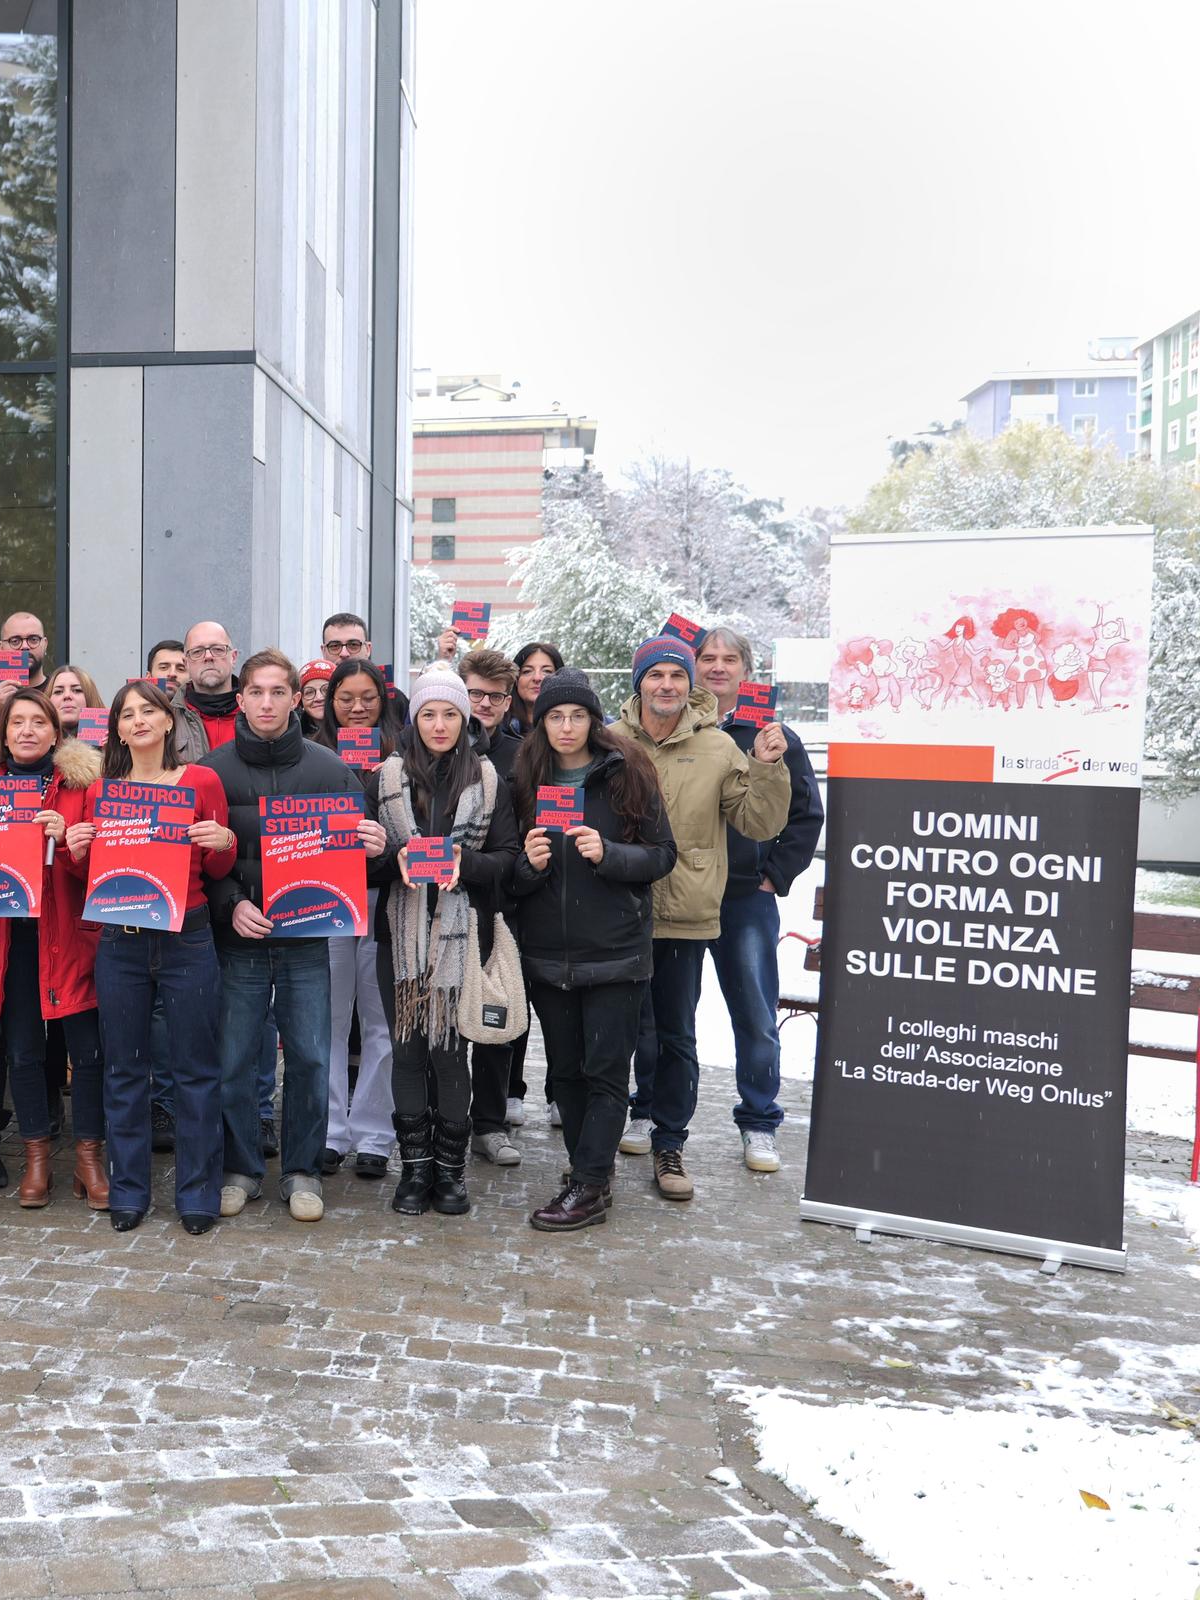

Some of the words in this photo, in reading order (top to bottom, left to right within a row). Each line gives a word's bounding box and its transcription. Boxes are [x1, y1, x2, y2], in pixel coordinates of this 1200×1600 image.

[1002, 756, 1014, 769] la
[1016, 756, 1059, 771] strada
[1082, 758, 1106, 772] der
[1109, 760, 1138, 776] weg
[107, 781, 192, 806] SÜDTIROL
[271, 797, 360, 815] SÜDTIROL
[100, 801, 154, 819] STEHT
[265, 816, 323, 833] STEHT
[152, 825, 187, 841] AUF
[325, 832, 360, 848] AUF
[913, 811, 1037, 841] UOMINI
[851, 844, 998, 875] CONTRO
[1010, 853, 1101, 882] OGNI
[887, 882, 1013, 914] FORMA
[1025, 890, 1058, 917] DI
[883, 917, 1060, 954] VIOLENZA
[846, 950, 956, 982] SULLE
[968, 960, 1096, 995] DONNE
[888, 1017, 892, 1032] I
[900, 1020, 976, 1044] colleghi
[984, 1031, 1058, 1050] maschi
[924, 1044, 1062, 1077] Associazione
[872, 1063, 981, 1092] Strada-der
[986, 1077, 1033, 1103] Weg
